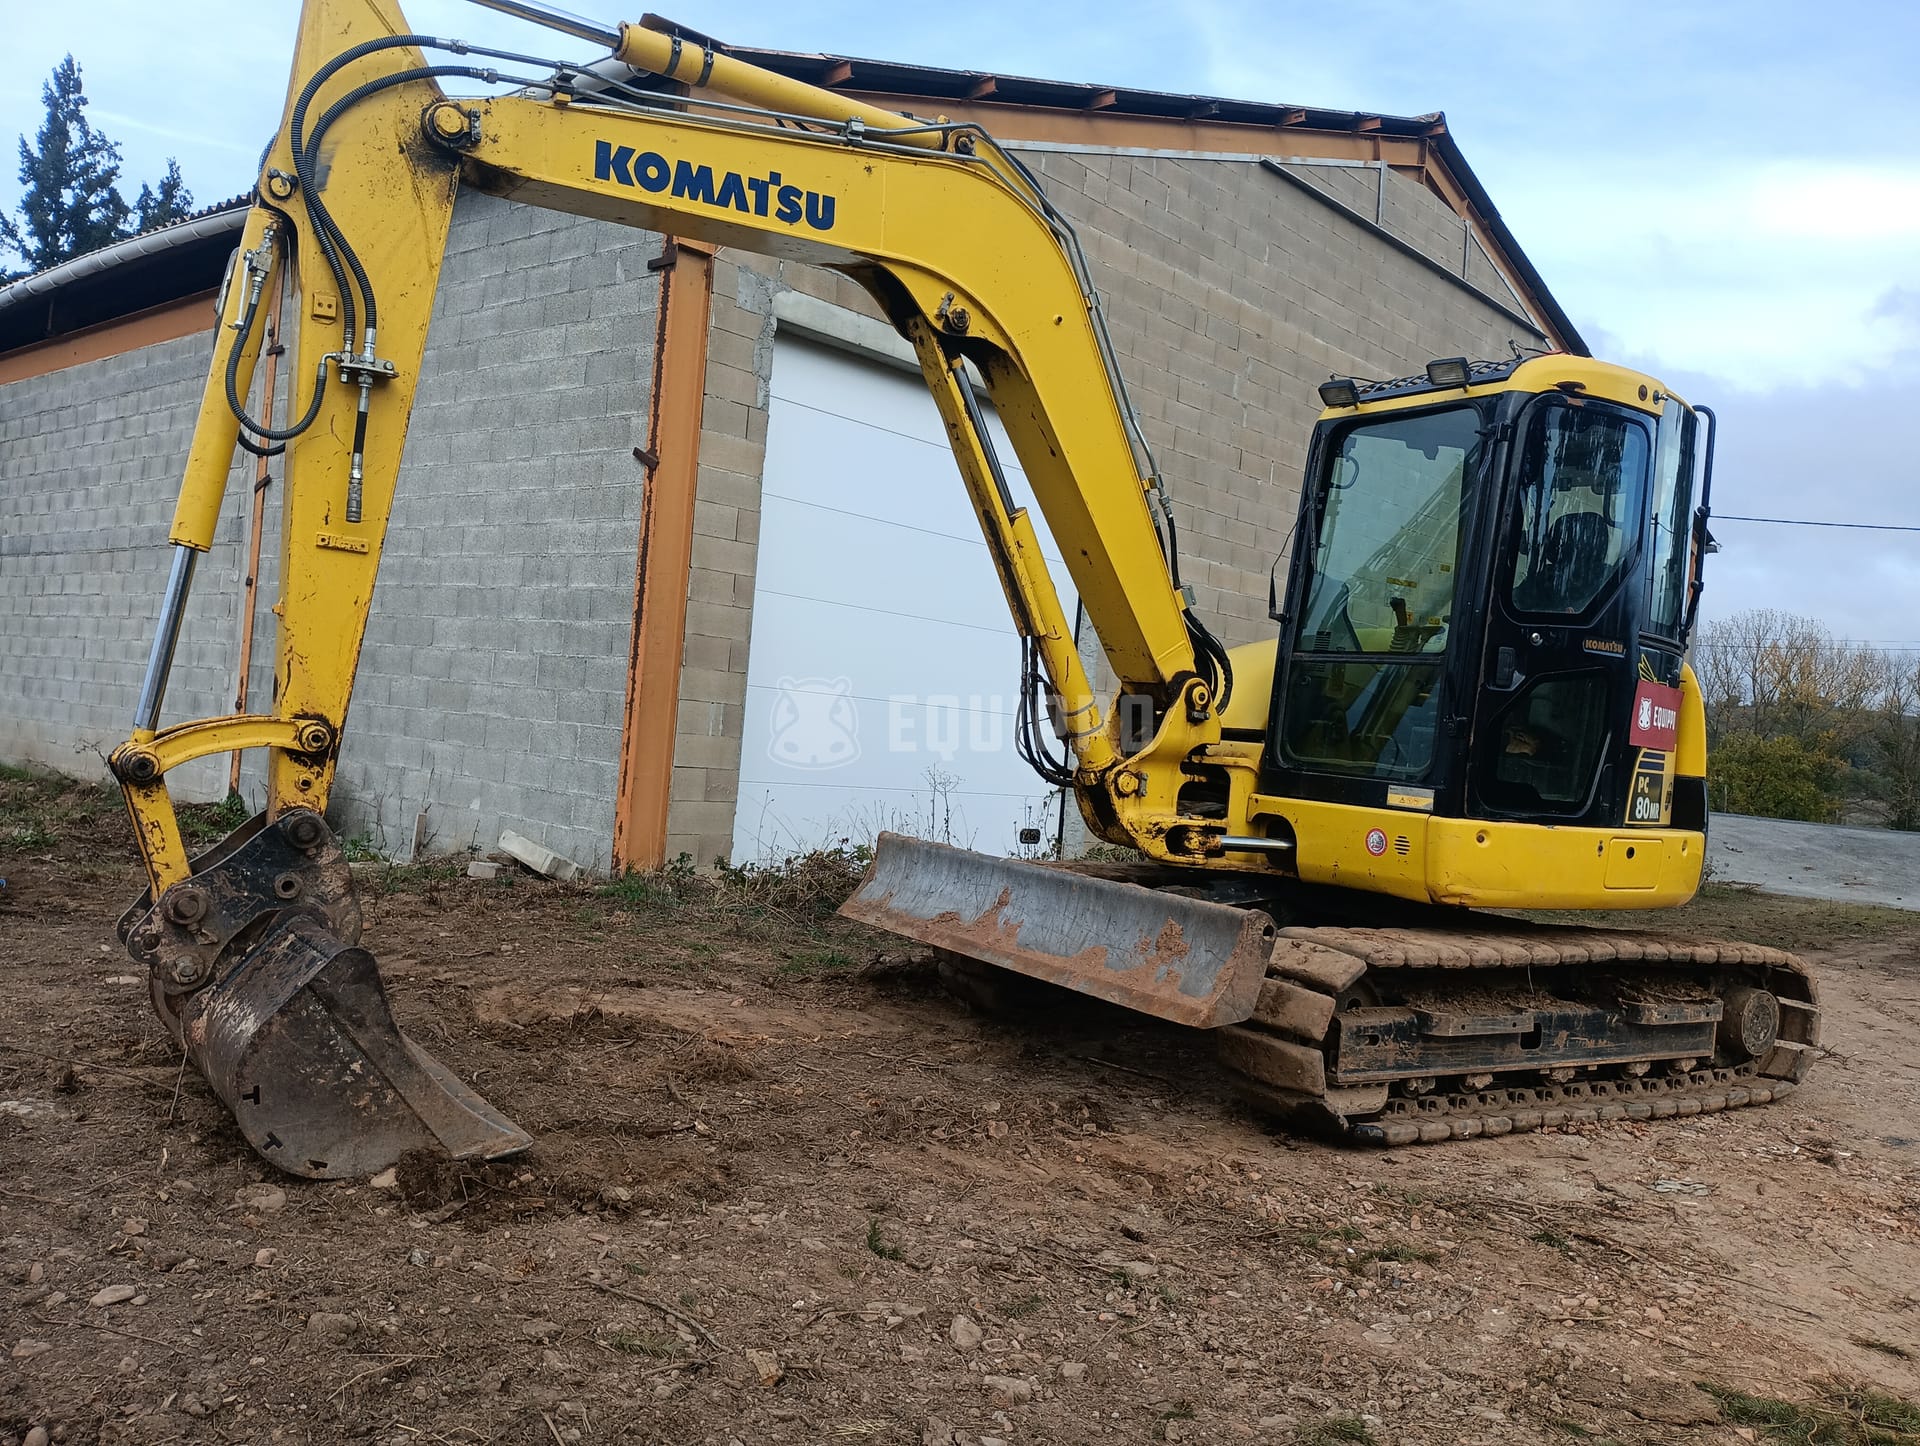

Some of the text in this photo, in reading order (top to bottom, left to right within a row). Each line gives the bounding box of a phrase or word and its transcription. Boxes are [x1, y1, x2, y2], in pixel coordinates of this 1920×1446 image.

[595, 140, 836, 231] KOMATSU
[1585, 639, 1624, 653] KOMATSU
[1637, 776, 1650, 794] PC
